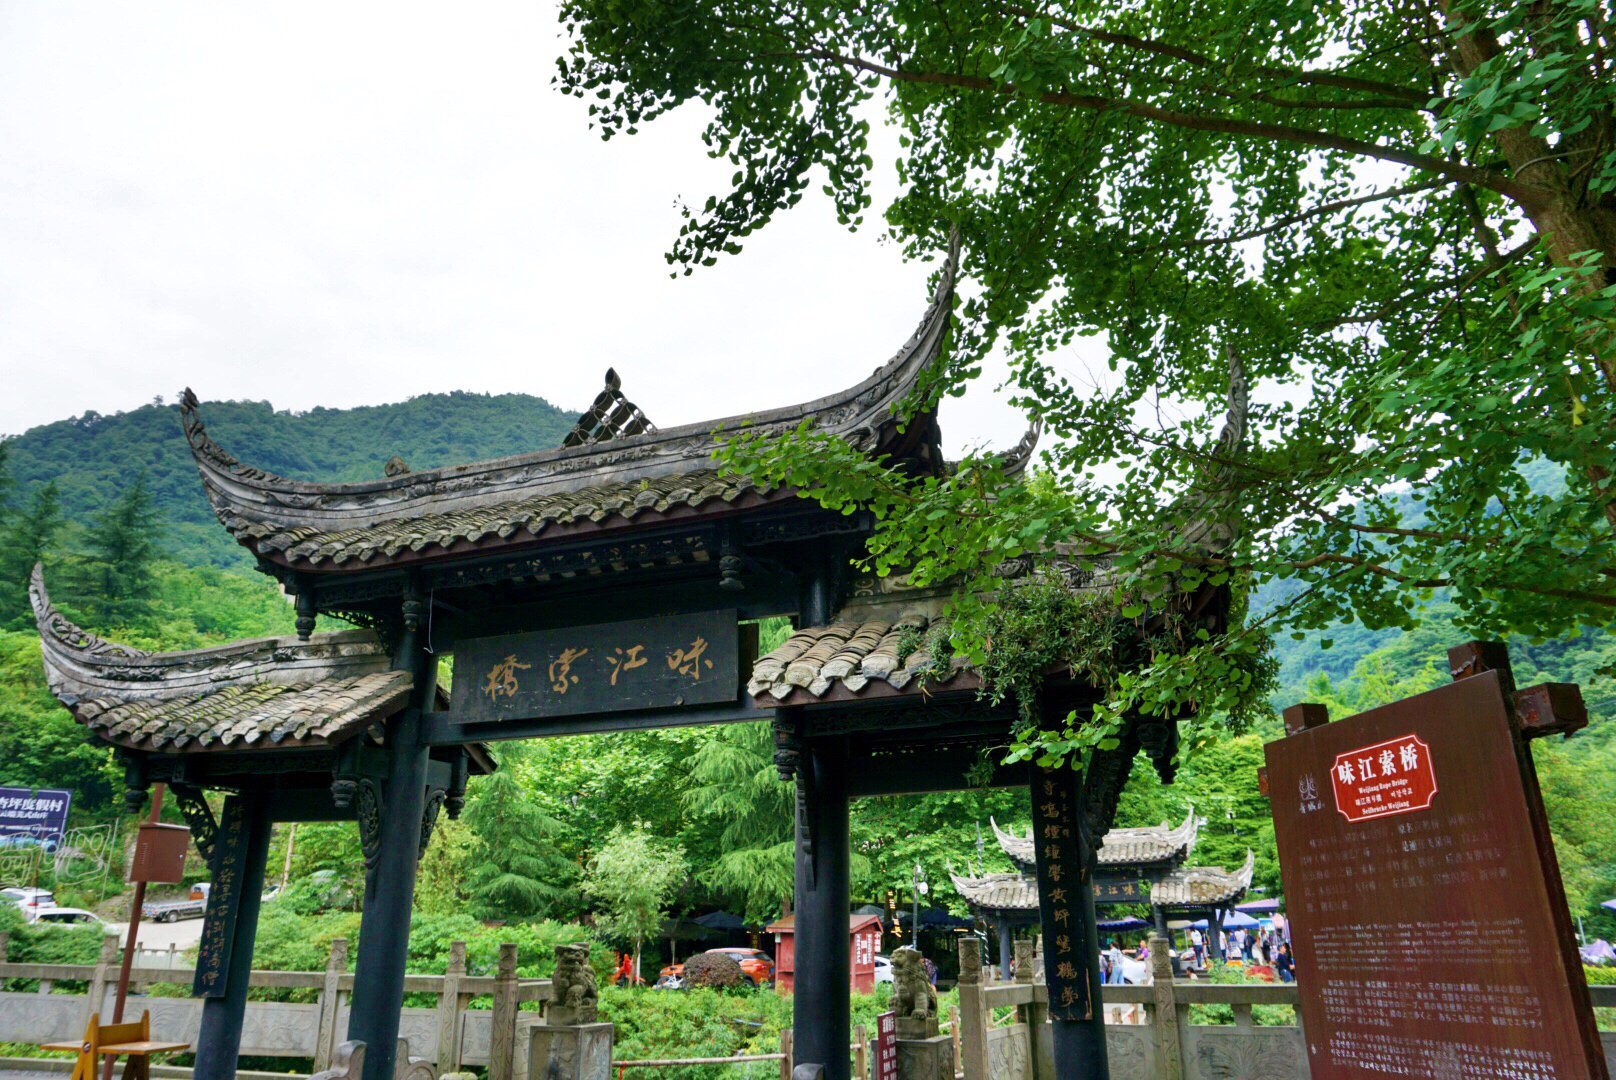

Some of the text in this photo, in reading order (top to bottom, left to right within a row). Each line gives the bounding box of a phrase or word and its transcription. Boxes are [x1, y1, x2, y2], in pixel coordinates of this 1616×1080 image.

[1337, 743, 1419, 785] 味江索桥
[1358, 778, 1409, 795] Weijiang Rope Bridge
[1387, 800, 1410, 811] Weijiang
